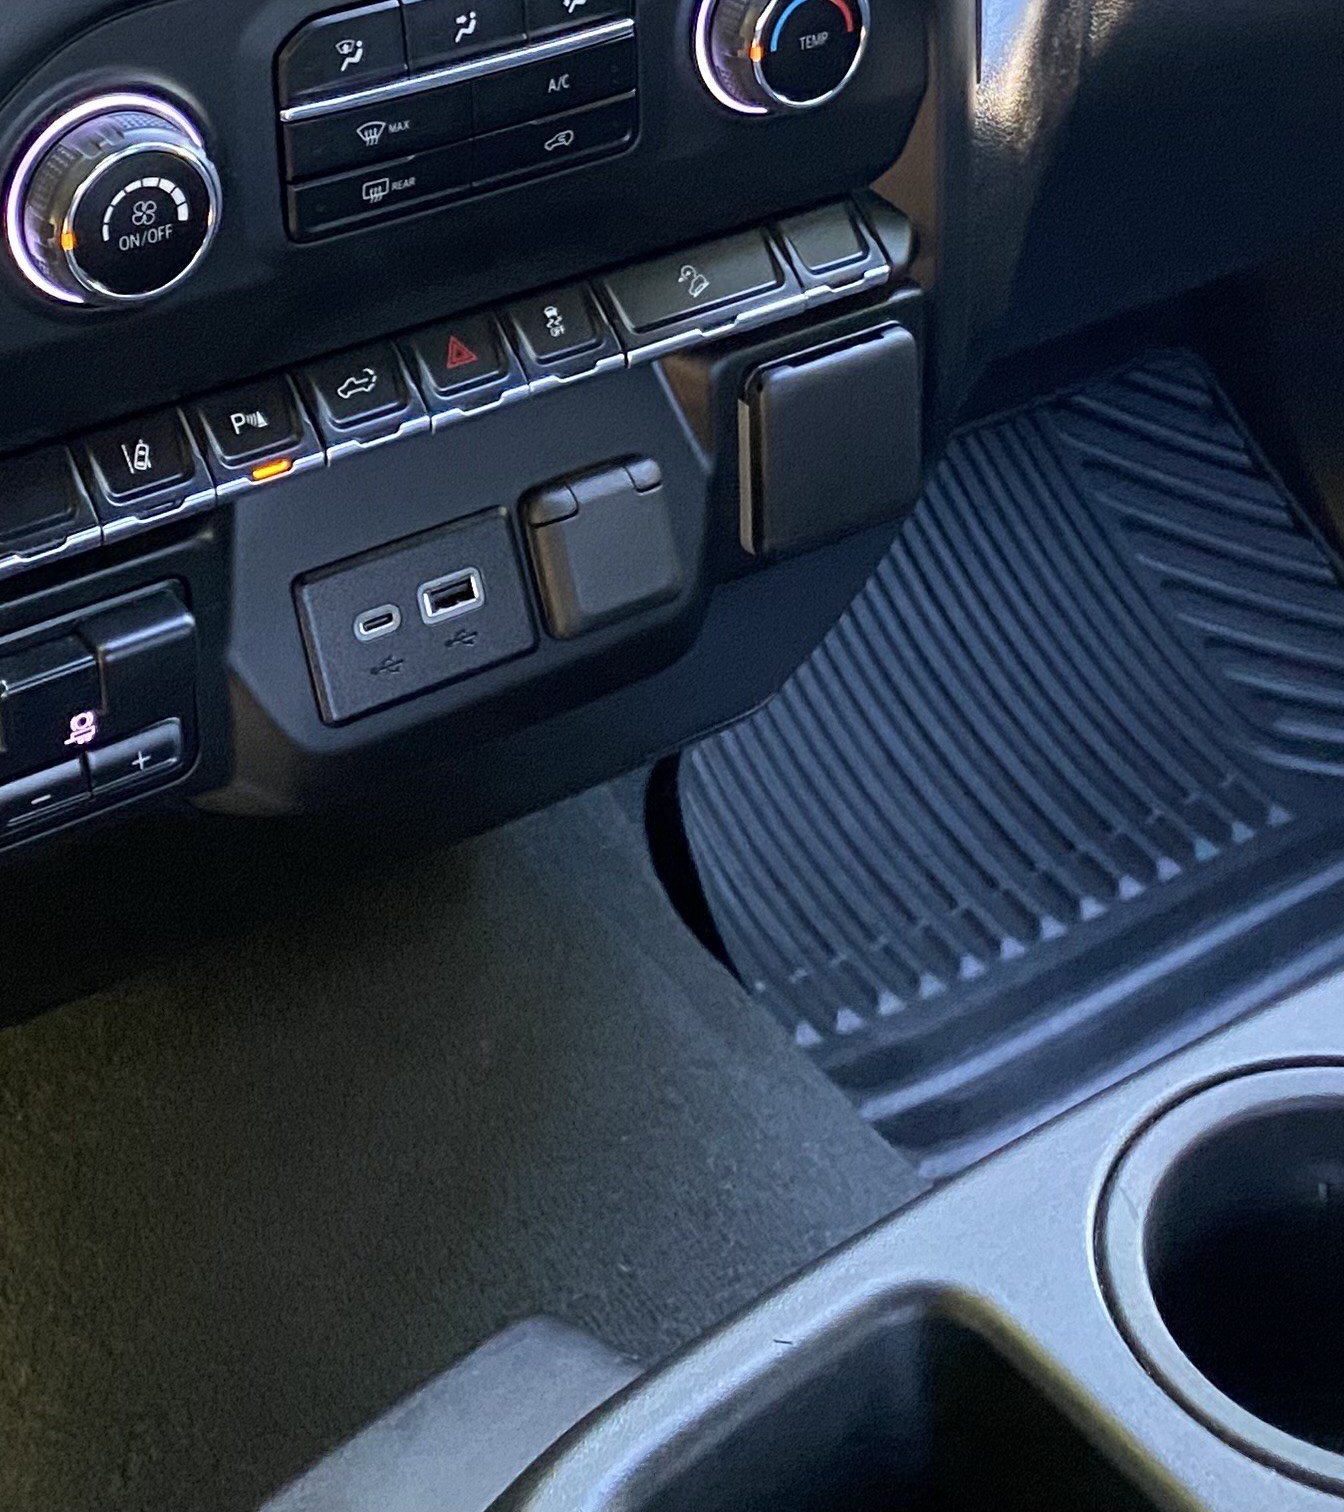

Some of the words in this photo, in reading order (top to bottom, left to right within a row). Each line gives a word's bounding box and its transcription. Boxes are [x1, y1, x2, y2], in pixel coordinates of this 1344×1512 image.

[547, 73, 570, 93] A/C
[388, 120, 411, 134] MAX
[391, 176, 416, 191] REAR
[118, 223, 173, 251] ON/OFF
